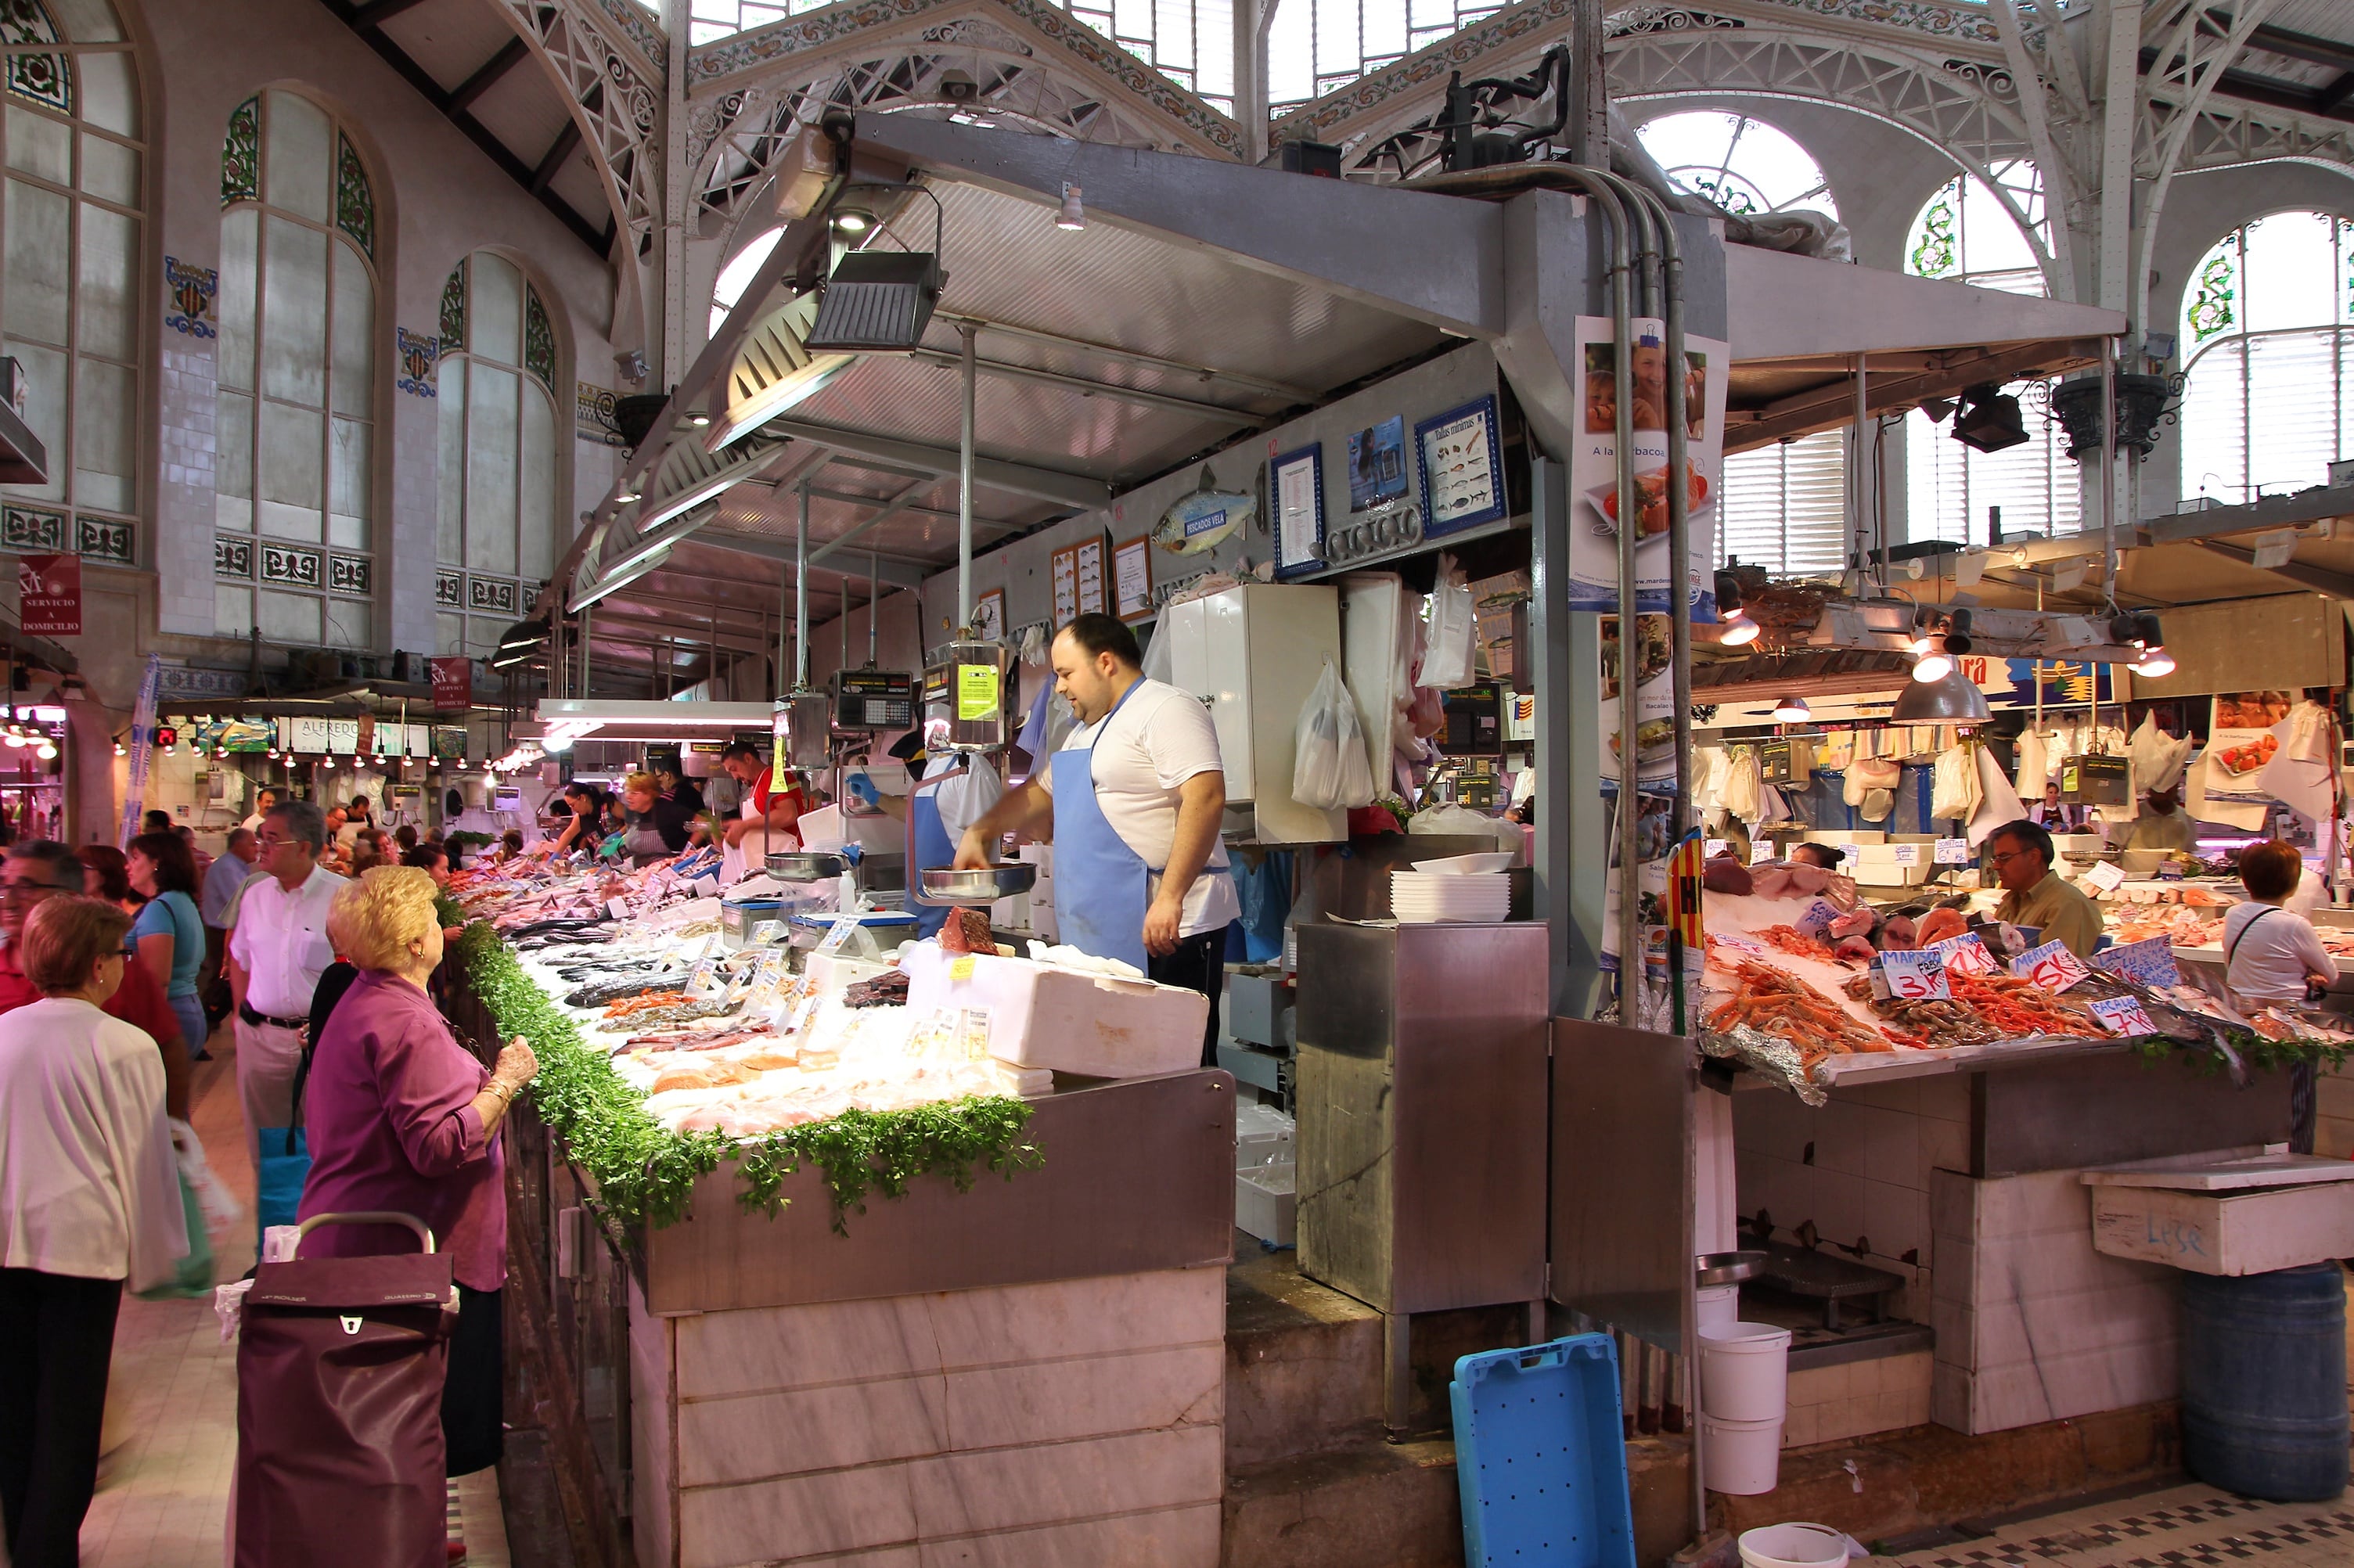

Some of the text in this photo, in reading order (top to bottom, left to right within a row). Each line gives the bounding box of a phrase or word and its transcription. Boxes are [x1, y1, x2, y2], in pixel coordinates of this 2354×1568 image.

[1268, 438, 1279, 458] 12
[1593, 447, 1601, 455] A
[1604, 447, 1614, 455] la
[1186, 513, 1226, 534] PESCADOS VELA
[23, 622, 79, 631] DOMICILIO
[302, 721, 359, 734] ALFREDO
[2032, 960, 2063, 987] 6
[1899, 976, 1927, 998] 3
[2105, 1012, 2132, 1036] 7
